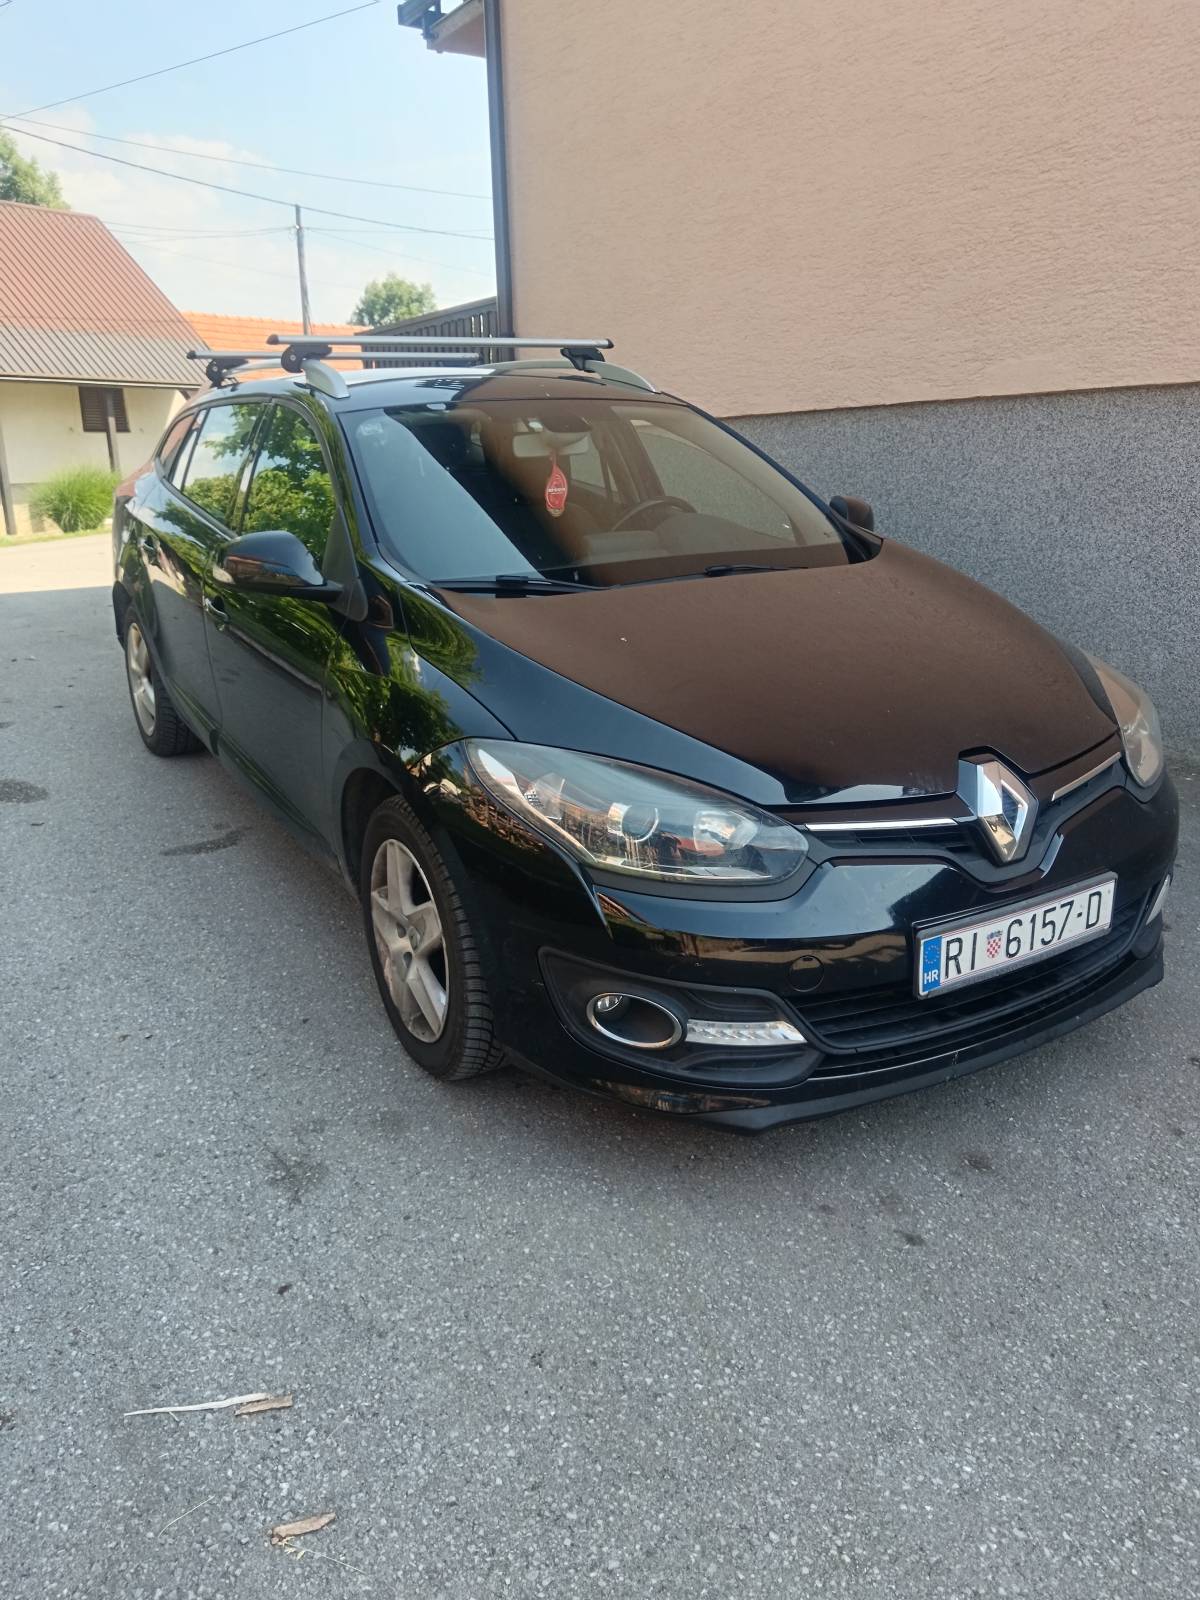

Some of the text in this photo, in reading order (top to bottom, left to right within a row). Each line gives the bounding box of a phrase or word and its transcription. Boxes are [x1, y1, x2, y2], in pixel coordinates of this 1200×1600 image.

[945, 932, 978, 979] RI
[1005, 891, 1102, 959] 6157-D
[924, 969, 939, 985] HR
